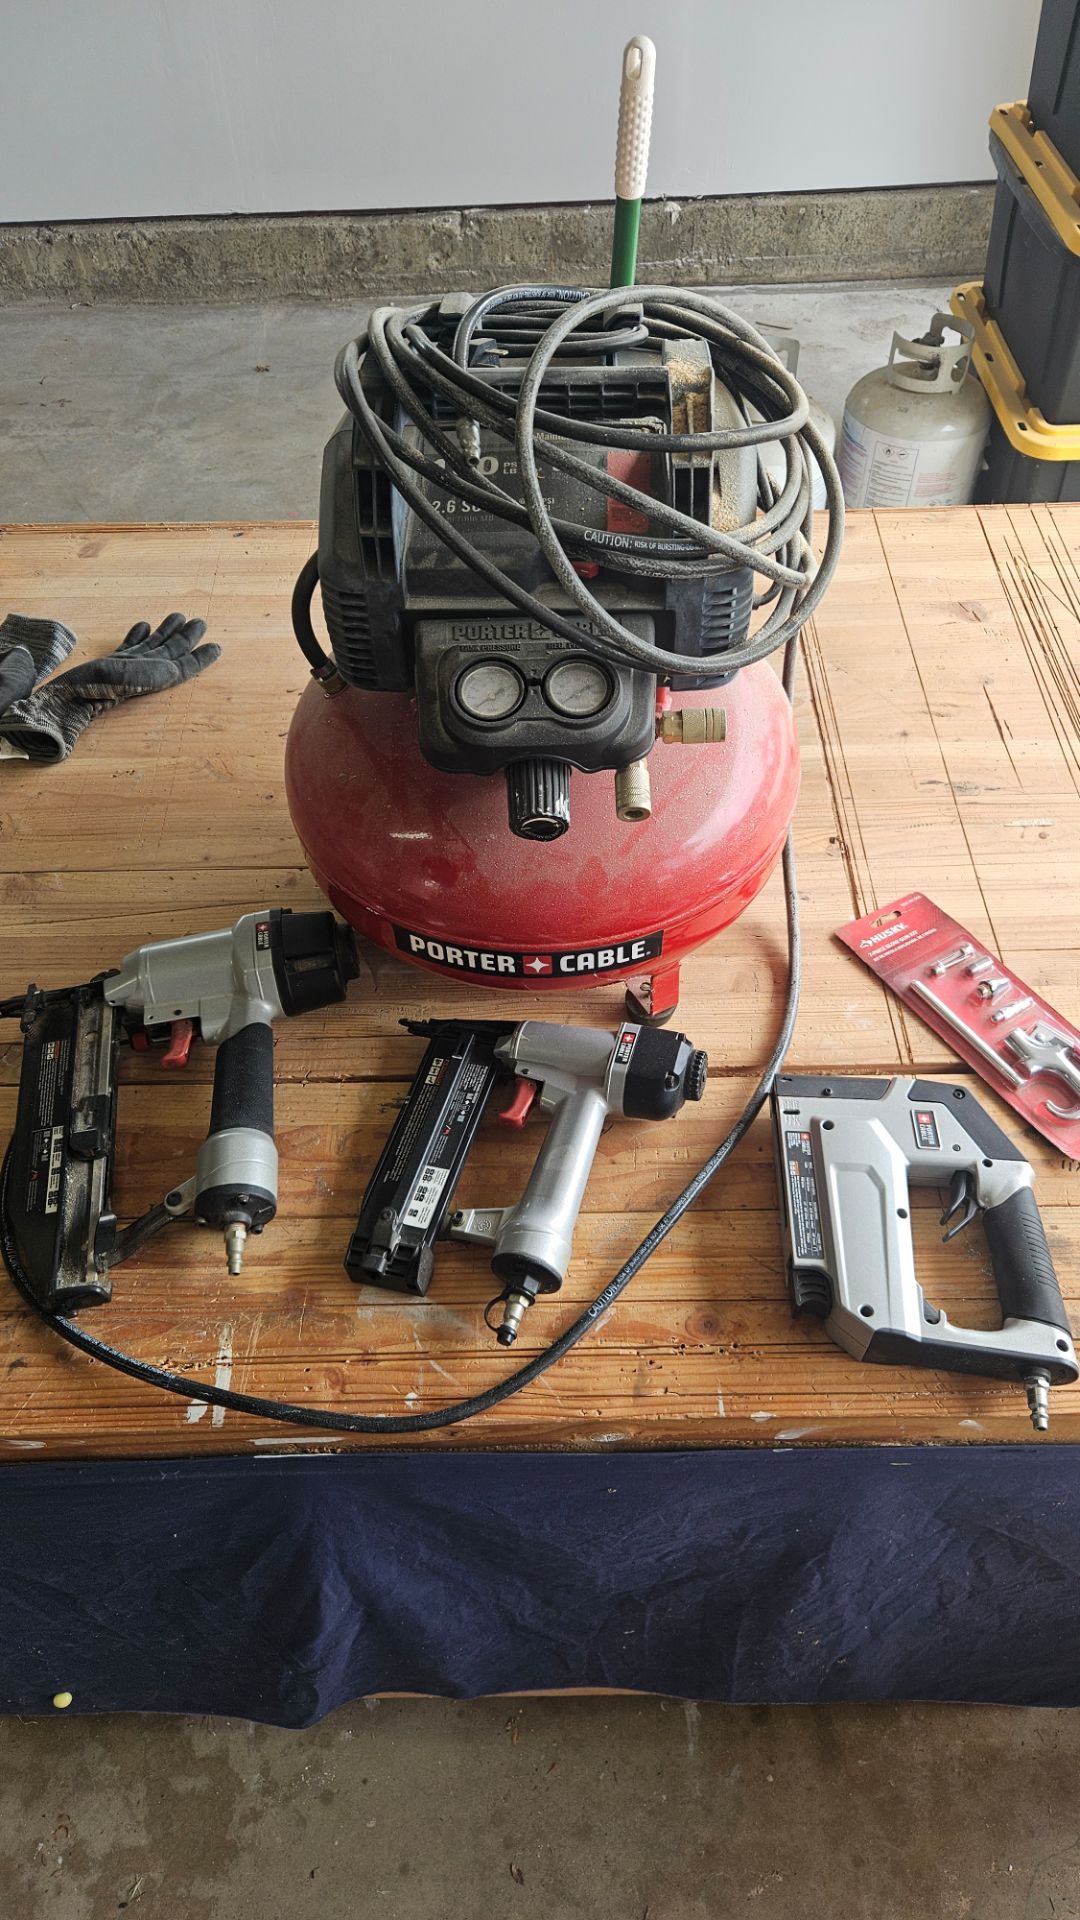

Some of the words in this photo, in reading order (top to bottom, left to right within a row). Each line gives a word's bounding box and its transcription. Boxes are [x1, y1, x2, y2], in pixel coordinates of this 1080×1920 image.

[431, 499, 456, 514] 2.6
[584, 529, 632, 549] CAUTION:
[634, 540, 648, 549] RISK
[869, 923, 905, 945] HUSKY
[409, 934, 516, 974] PORTER
[587, 1282, 620, 1317] CAUTION:
